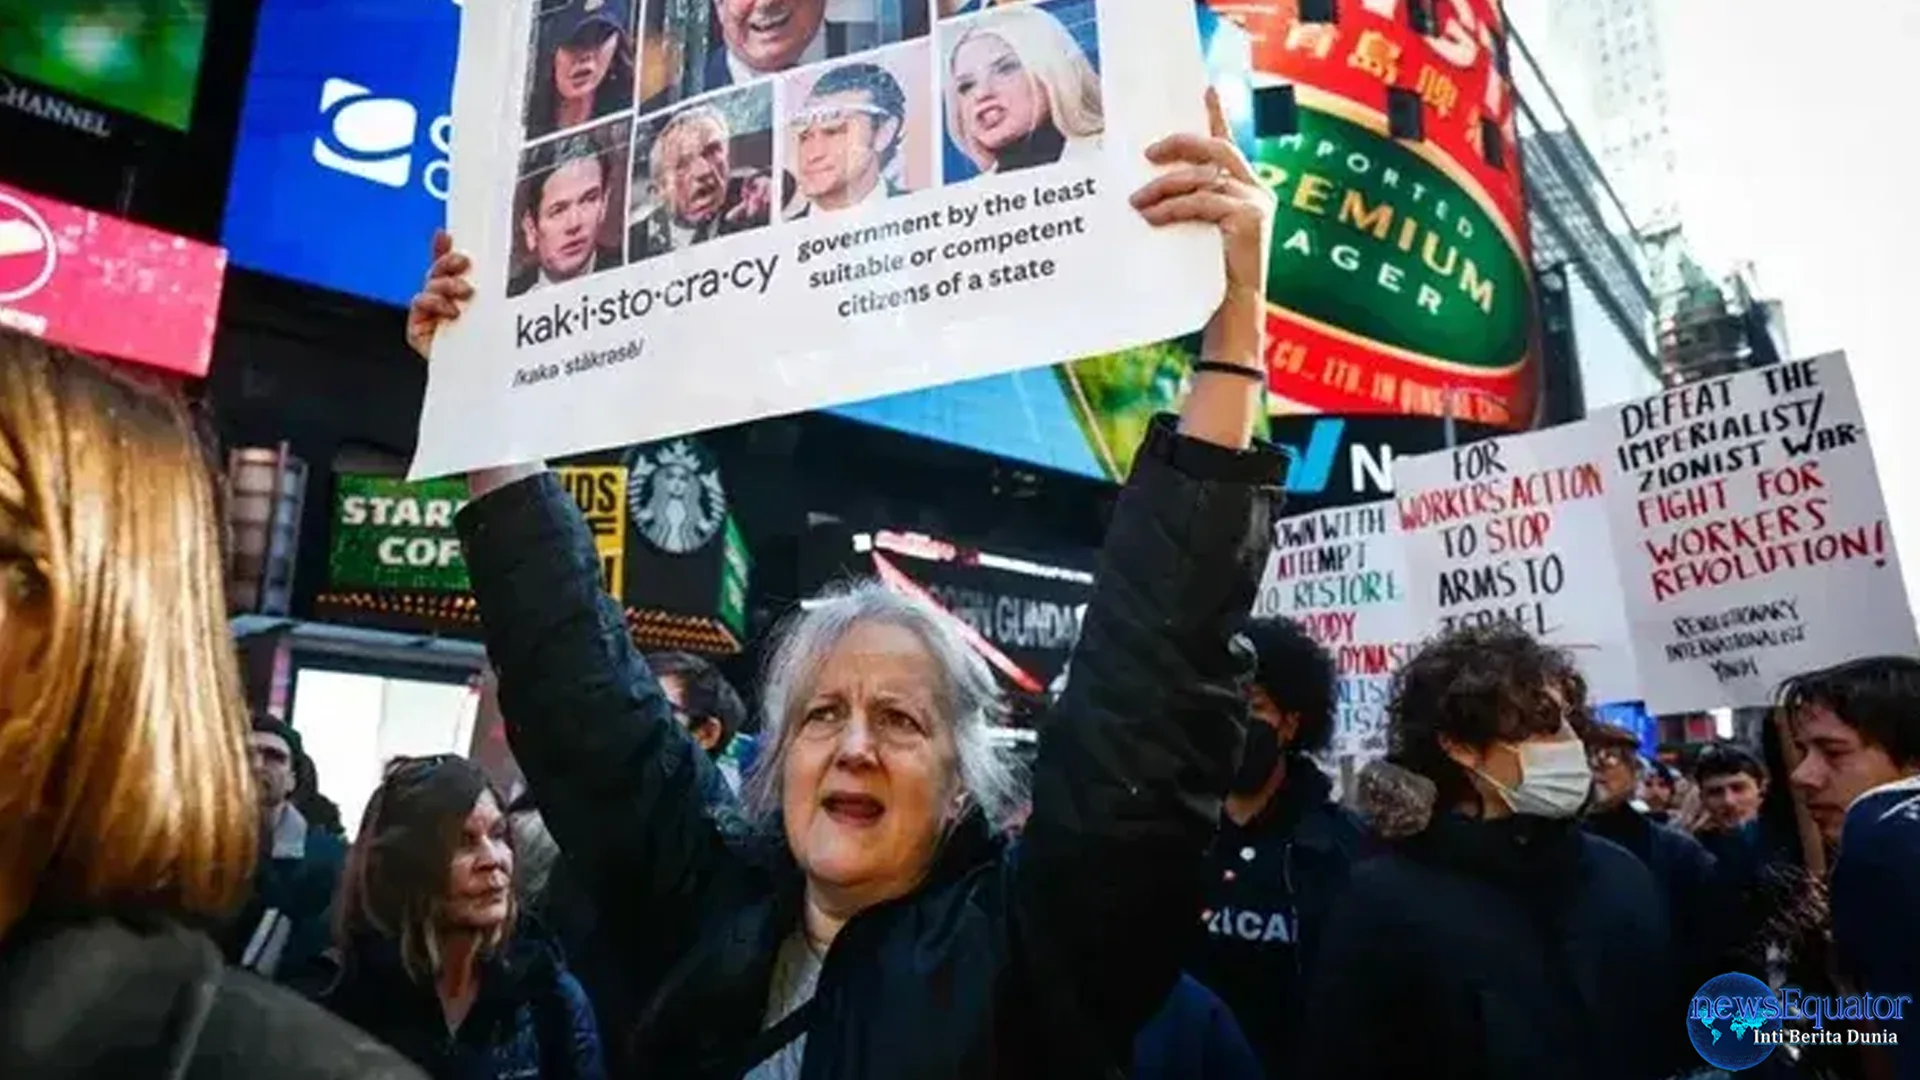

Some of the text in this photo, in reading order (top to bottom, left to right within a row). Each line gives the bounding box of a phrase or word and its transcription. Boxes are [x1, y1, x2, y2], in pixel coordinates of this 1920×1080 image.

[797, 176, 1096, 263] government by the least
[809, 215, 1085, 288] suitable or competent
[838, 257, 1055, 317] citizens of a state
[1621, 358, 1820, 439] DEFEAT THE
[1453, 439, 1506, 481] FOR
[1638, 439, 1766, 493] ZIONIST
[341, 495, 469, 528] STAR
[1397, 463, 1603, 531] WORKERS ACTION
[1637, 460, 1825, 528] FIGHT FOR
[1320, 508, 1385, 540] WITH
[1439, 512, 1550, 558] TO STOP
[1646, 498, 1828, 566] WORKERS
[1277, 541, 1365, 580] ATTEMPT
[1438, 553, 1565, 608] ARMS TO
[1650, 521, 1886, 602] REVOLUTION!
[1294, 570, 1395, 609] RESTORE
